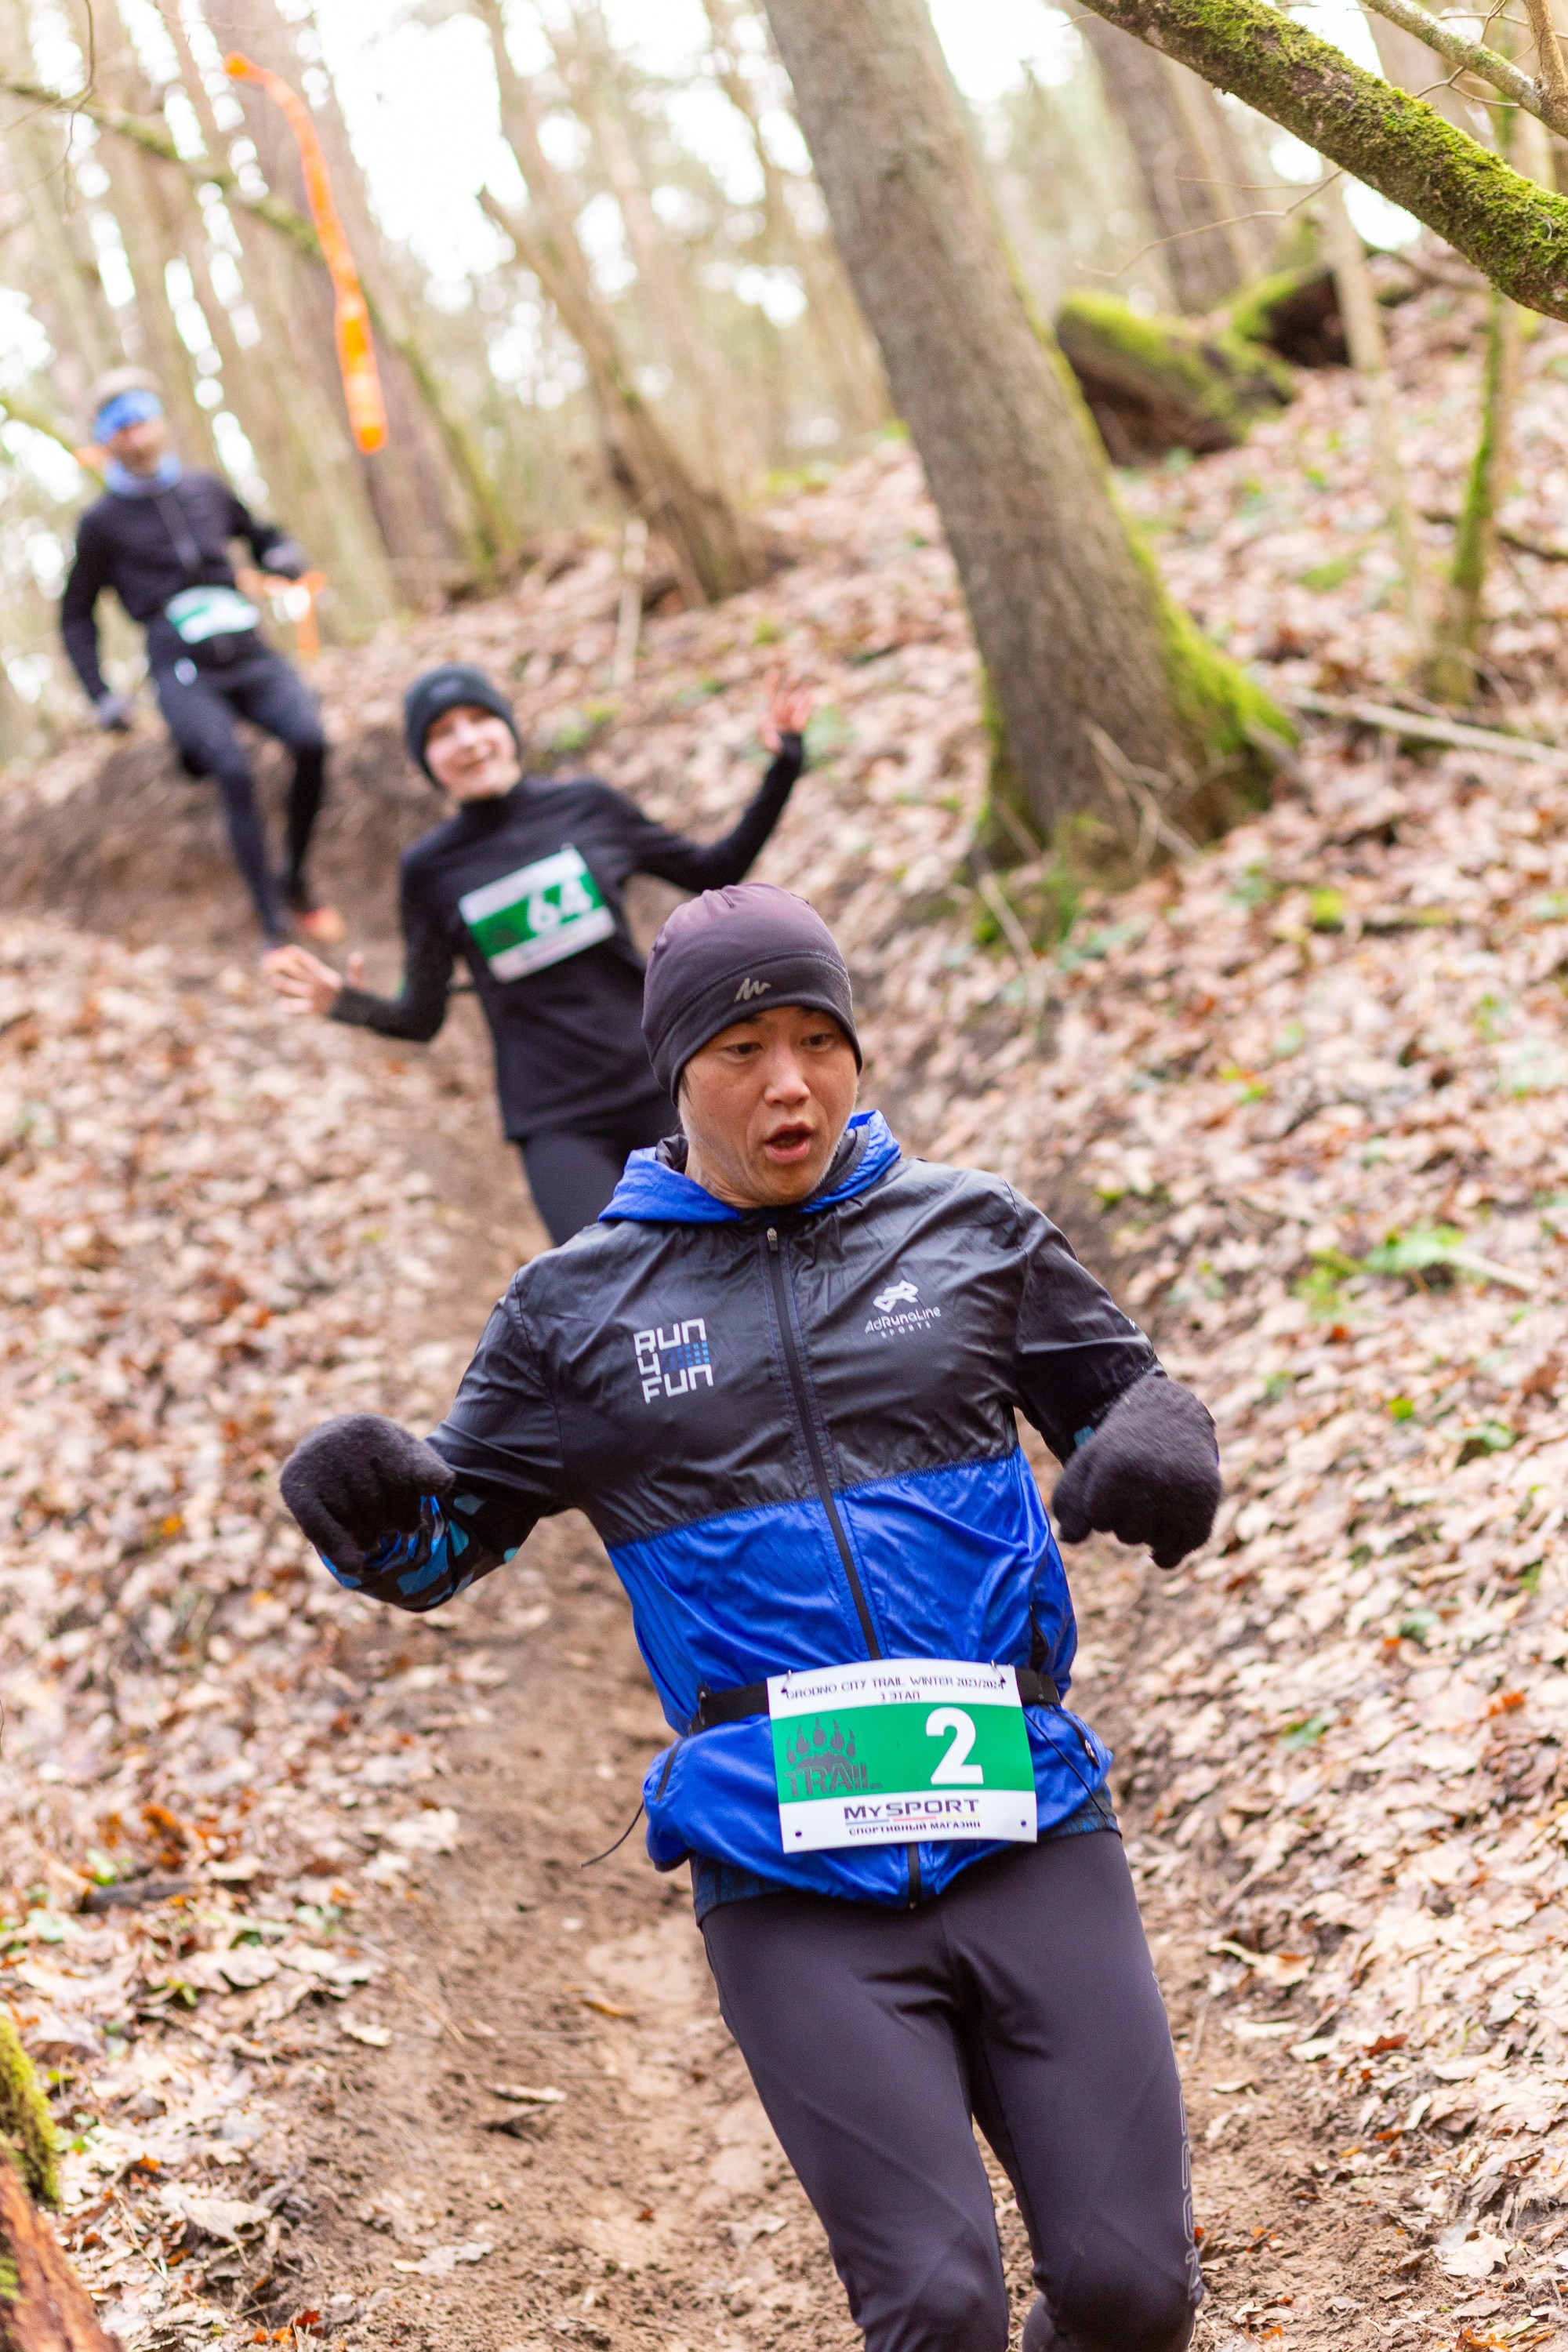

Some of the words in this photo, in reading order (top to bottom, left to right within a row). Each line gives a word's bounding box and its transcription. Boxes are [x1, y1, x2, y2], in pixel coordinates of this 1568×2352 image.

[528, 878, 593, 932] 64
[786, 1684, 837, 1700] GRODNO
[841, 1679, 866, 1693] CITY
[909, 1675, 953, 1687] WINTER
[926, 1707, 984, 1785] 2
[849, 1822, 927, 1836] СПОРТИВНЫЙ
[930, 1820, 981, 1831] МАГАЗИН
